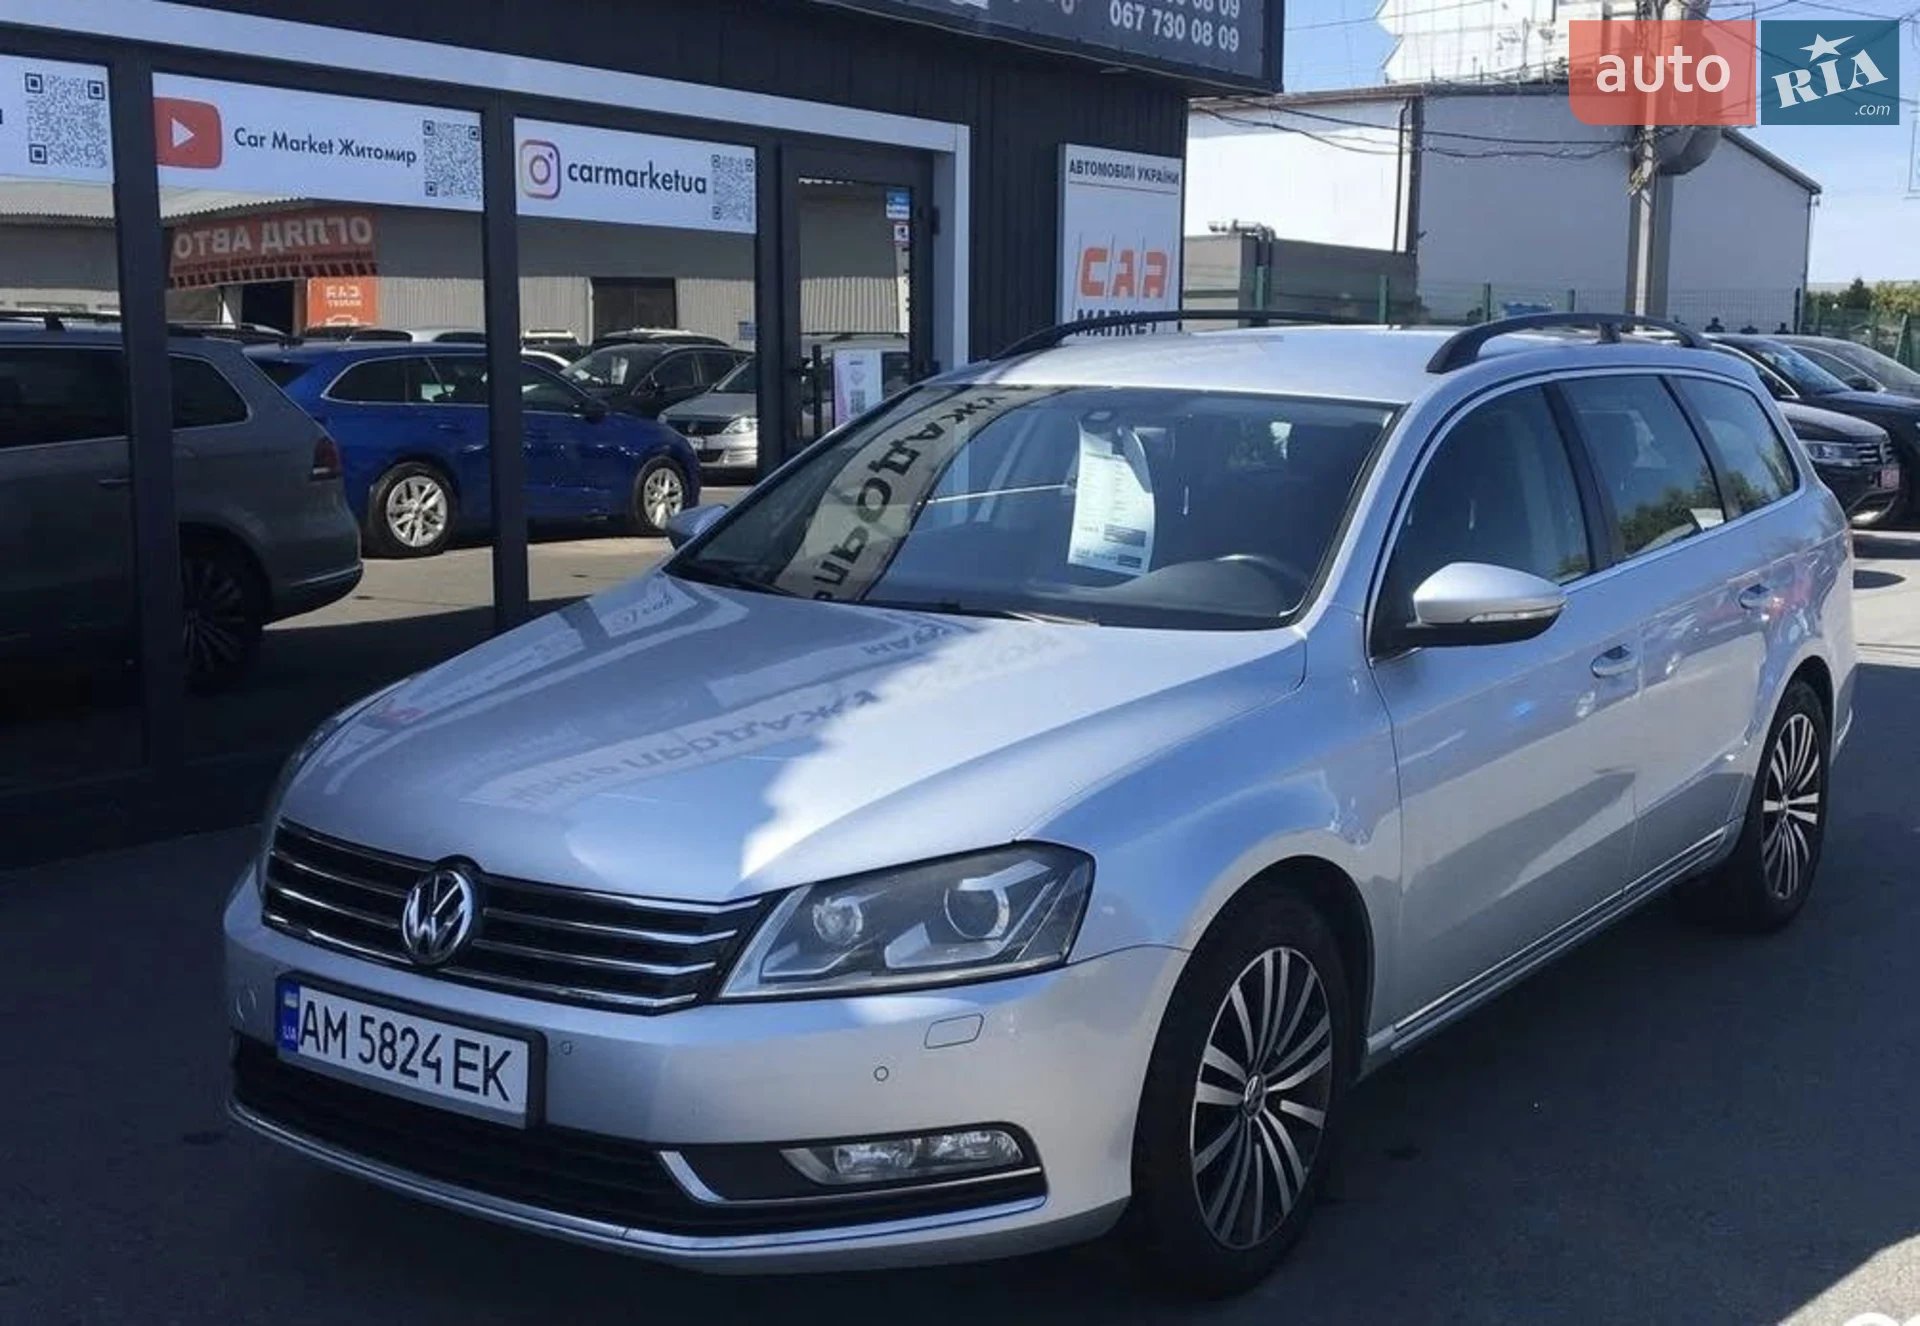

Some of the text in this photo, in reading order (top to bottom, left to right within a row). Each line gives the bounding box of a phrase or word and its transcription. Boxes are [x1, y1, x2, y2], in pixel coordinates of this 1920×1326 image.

[1109, 0, 1240, 53] 067 730 08 09
[233, 126, 417, 169] Car Market Житомир
[567, 160, 707, 195] carmarketua
[1079, 246, 1169, 299] CAR
[300, 1000, 511, 1102] AM 5824 EK
